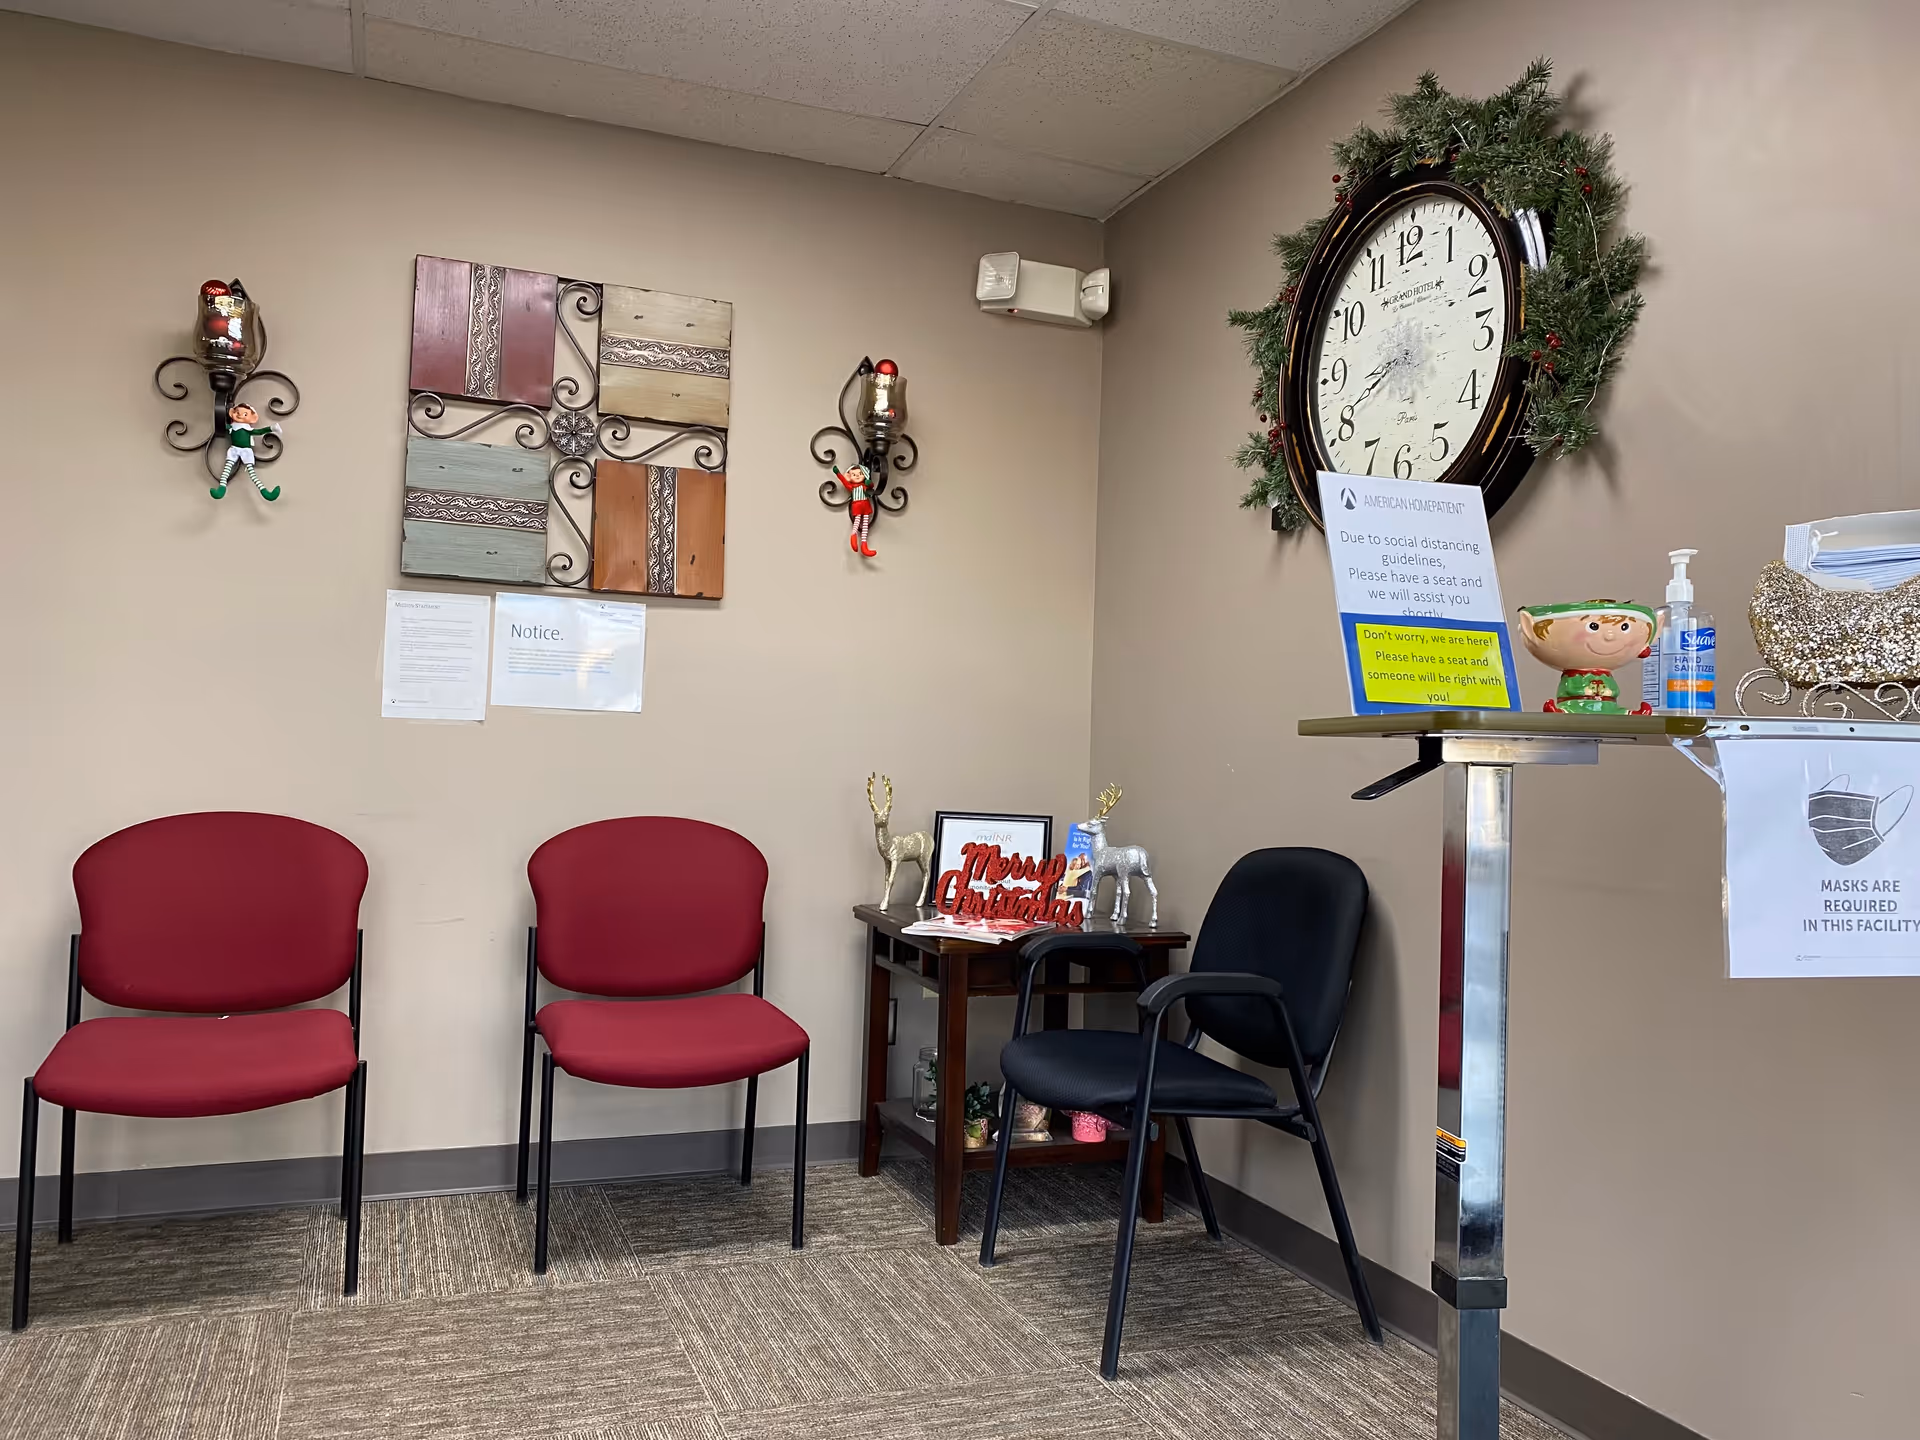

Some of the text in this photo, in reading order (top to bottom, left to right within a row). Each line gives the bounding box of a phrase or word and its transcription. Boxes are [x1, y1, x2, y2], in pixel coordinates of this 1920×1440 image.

[1398, 225, 1424, 267] 12
[1446, 226, 1454, 263] 1
[1369, 254, 1387, 293] 11
[1467, 254, 1489, 298] 2
[1389, 289, 1413, 305] GRAND
[1413, 281, 1435, 296] HOTEL
[1342, 301, 1365, 342] 10
[1473, 307, 1494, 352] 3
[1331, 358, 1348, 395] 9
[1457, 369, 1481, 411] 4
[1338, 404, 1355, 442] 8
[1429, 421, 1449, 462] 5
[1364, 437, 1382, 476] 7
[1393, 444, 1412, 480] 6
[1364, 494, 1408, 511] AMERICAN
[1340, 530, 1480, 555] Due to social distancing
[1381, 553, 1446, 570] guidelines,
[1349, 567, 1483, 588] Please have a seat and
[1368, 589, 1470, 607] we will assist you
[511, 624, 564, 641] Notice.
[1363, 629, 1493, 647] Don't worry, we are here!
[1683, 632, 1715, 646] Suave
[1375, 651, 1489, 667] Please have a seat and
[1368, 671, 1501, 687] someone will be right with
[1427, 691, 1450, 703] you!
[961, 842, 1067, 905] Merry
[1821, 879, 1901, 893] MASKS ARE
[935, 869, 1084, 927] Christmas
[1824, 899, 1898, 914] REQUIRED
[1803, 919, 1920, 932] IN THIS FACILITY
